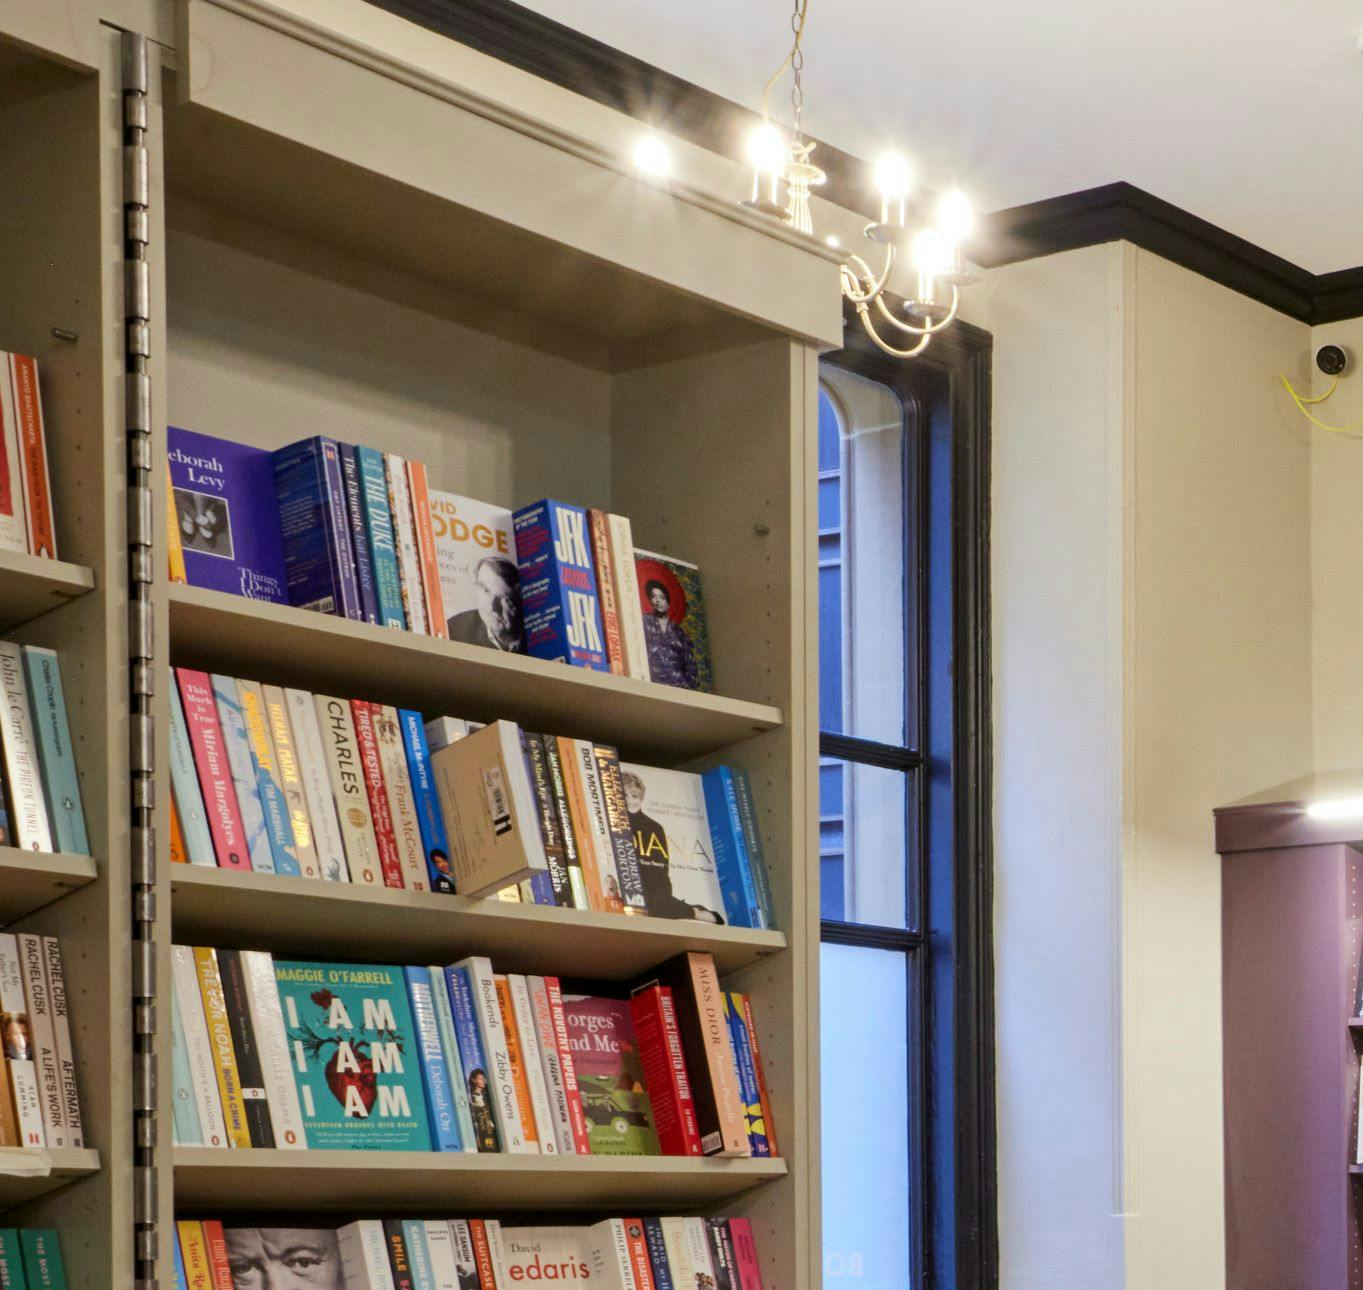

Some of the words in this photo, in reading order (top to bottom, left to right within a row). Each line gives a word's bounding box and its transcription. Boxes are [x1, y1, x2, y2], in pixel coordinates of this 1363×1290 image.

[168, 449, 223, 472] eborah
[188, 468, 224, 490] Levy
[366, 475, 385, 502] THE
[369, 507, 394, 553] DUKE
[431, 515, 510, 554] ODGE
[554, 506, 590, 568] JFK
[567, 590, 602, 652] JFK
[328, 701, 359, 795] CHARLES
[202, 728, 220, 776] Miriam
[214, 779, 235, 845] Margolyes
[615, 838, 633, 891] MORTON
[624, 841, 644, 892] ANDREW
[25, 938, 40, 984] RACHEL
[47, 941, 62, 986] RACHEL
[276, 969, 323, 981] MAGGIE
[329, 971, 392, 984] O'FARRELL
[32, 985, 46, 1015] CUSK
[53, 987, 66, 1017] CUSK
[201, 960, 224, 1020] TREVOR
[482, 979, 496, 1029] Bookends
[550, 986, 559, 1010] THE
[698, 966, 711, 1003] MISS
[707, 1007, 721, 1045] DIOR
[286, 996, 299, 1028] I
[568, 1011, 615, 1030] orges
[212, 1023, 232, 1067] NOAH
[554, 1012, 569, 1050] NOVOTNY
[568, 1036, 589, 1051] nd
[594, 1032, 620, 1053] Me
[294, 1041, 307, 1072] I
[496, 1052, 510, 1082] Zibby
[560, 1053, 576, 1091] PAPERS
[62, 1060, 80, 1129] AFTERMATH
[302, 1085, 316, 1117] I
[502, 1086, 514, 1119] Owens
[391, 1235, 401, 1271] SMILE
[511, 1243, 541, 1253] David
[509, 1254, 590, 1280] edaris
